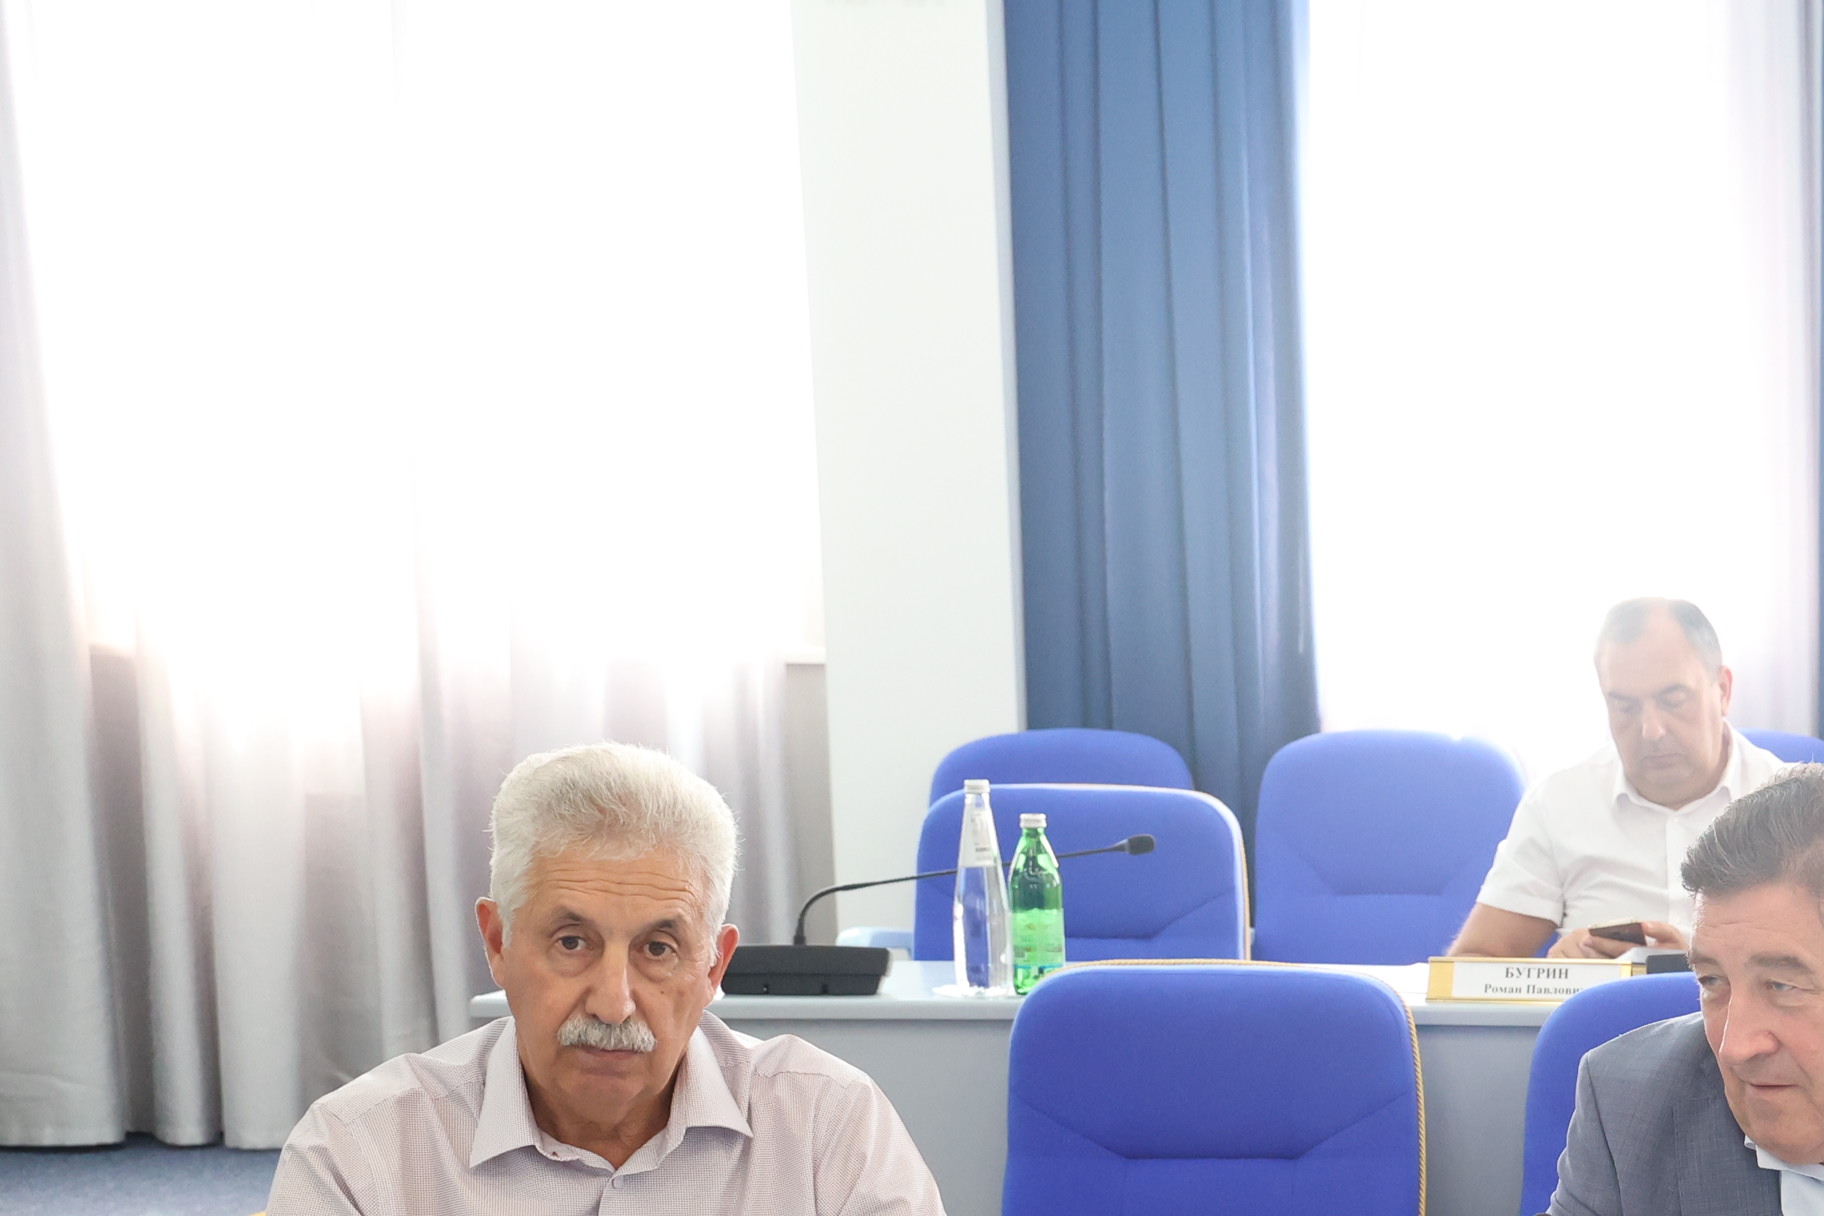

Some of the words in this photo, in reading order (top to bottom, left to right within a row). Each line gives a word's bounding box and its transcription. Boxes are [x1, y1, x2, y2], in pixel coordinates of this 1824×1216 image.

[1504, 966, 1569, 980] БУГРИН
[1484, 983, 1522, 994] Роман
[1526, 984, 1584, 995] Павлови
